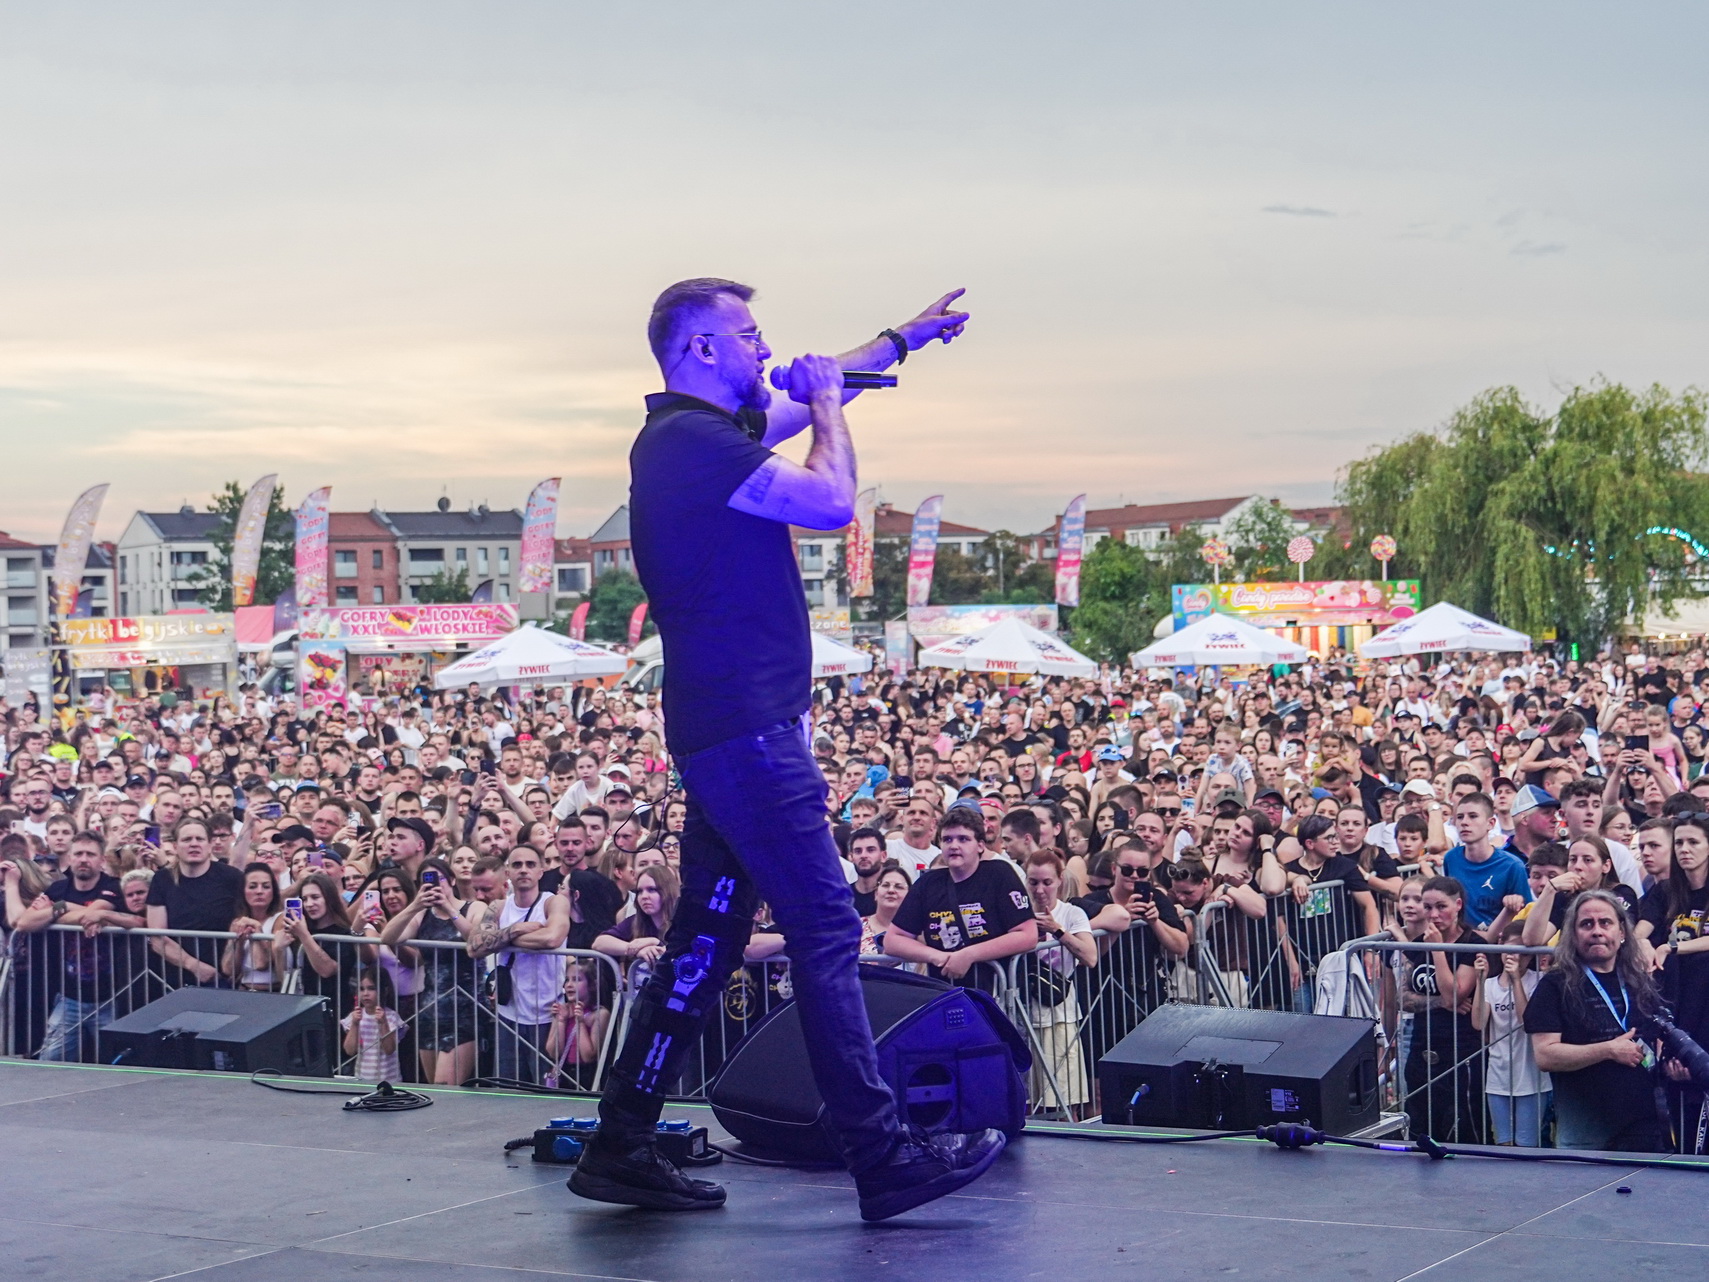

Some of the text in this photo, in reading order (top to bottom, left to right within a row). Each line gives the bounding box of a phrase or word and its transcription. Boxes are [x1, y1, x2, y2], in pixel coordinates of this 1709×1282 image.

[340, 608, 472, 623] GOFRY LODY
[60, 618, 204, 643] frytki belgijskie
[350, 622, 487, 636] XXL WŁOSKIE
[518, 664, 551, 675] ŻYWIEC
[986, 658, 1018, 670] ŻYWIEC
